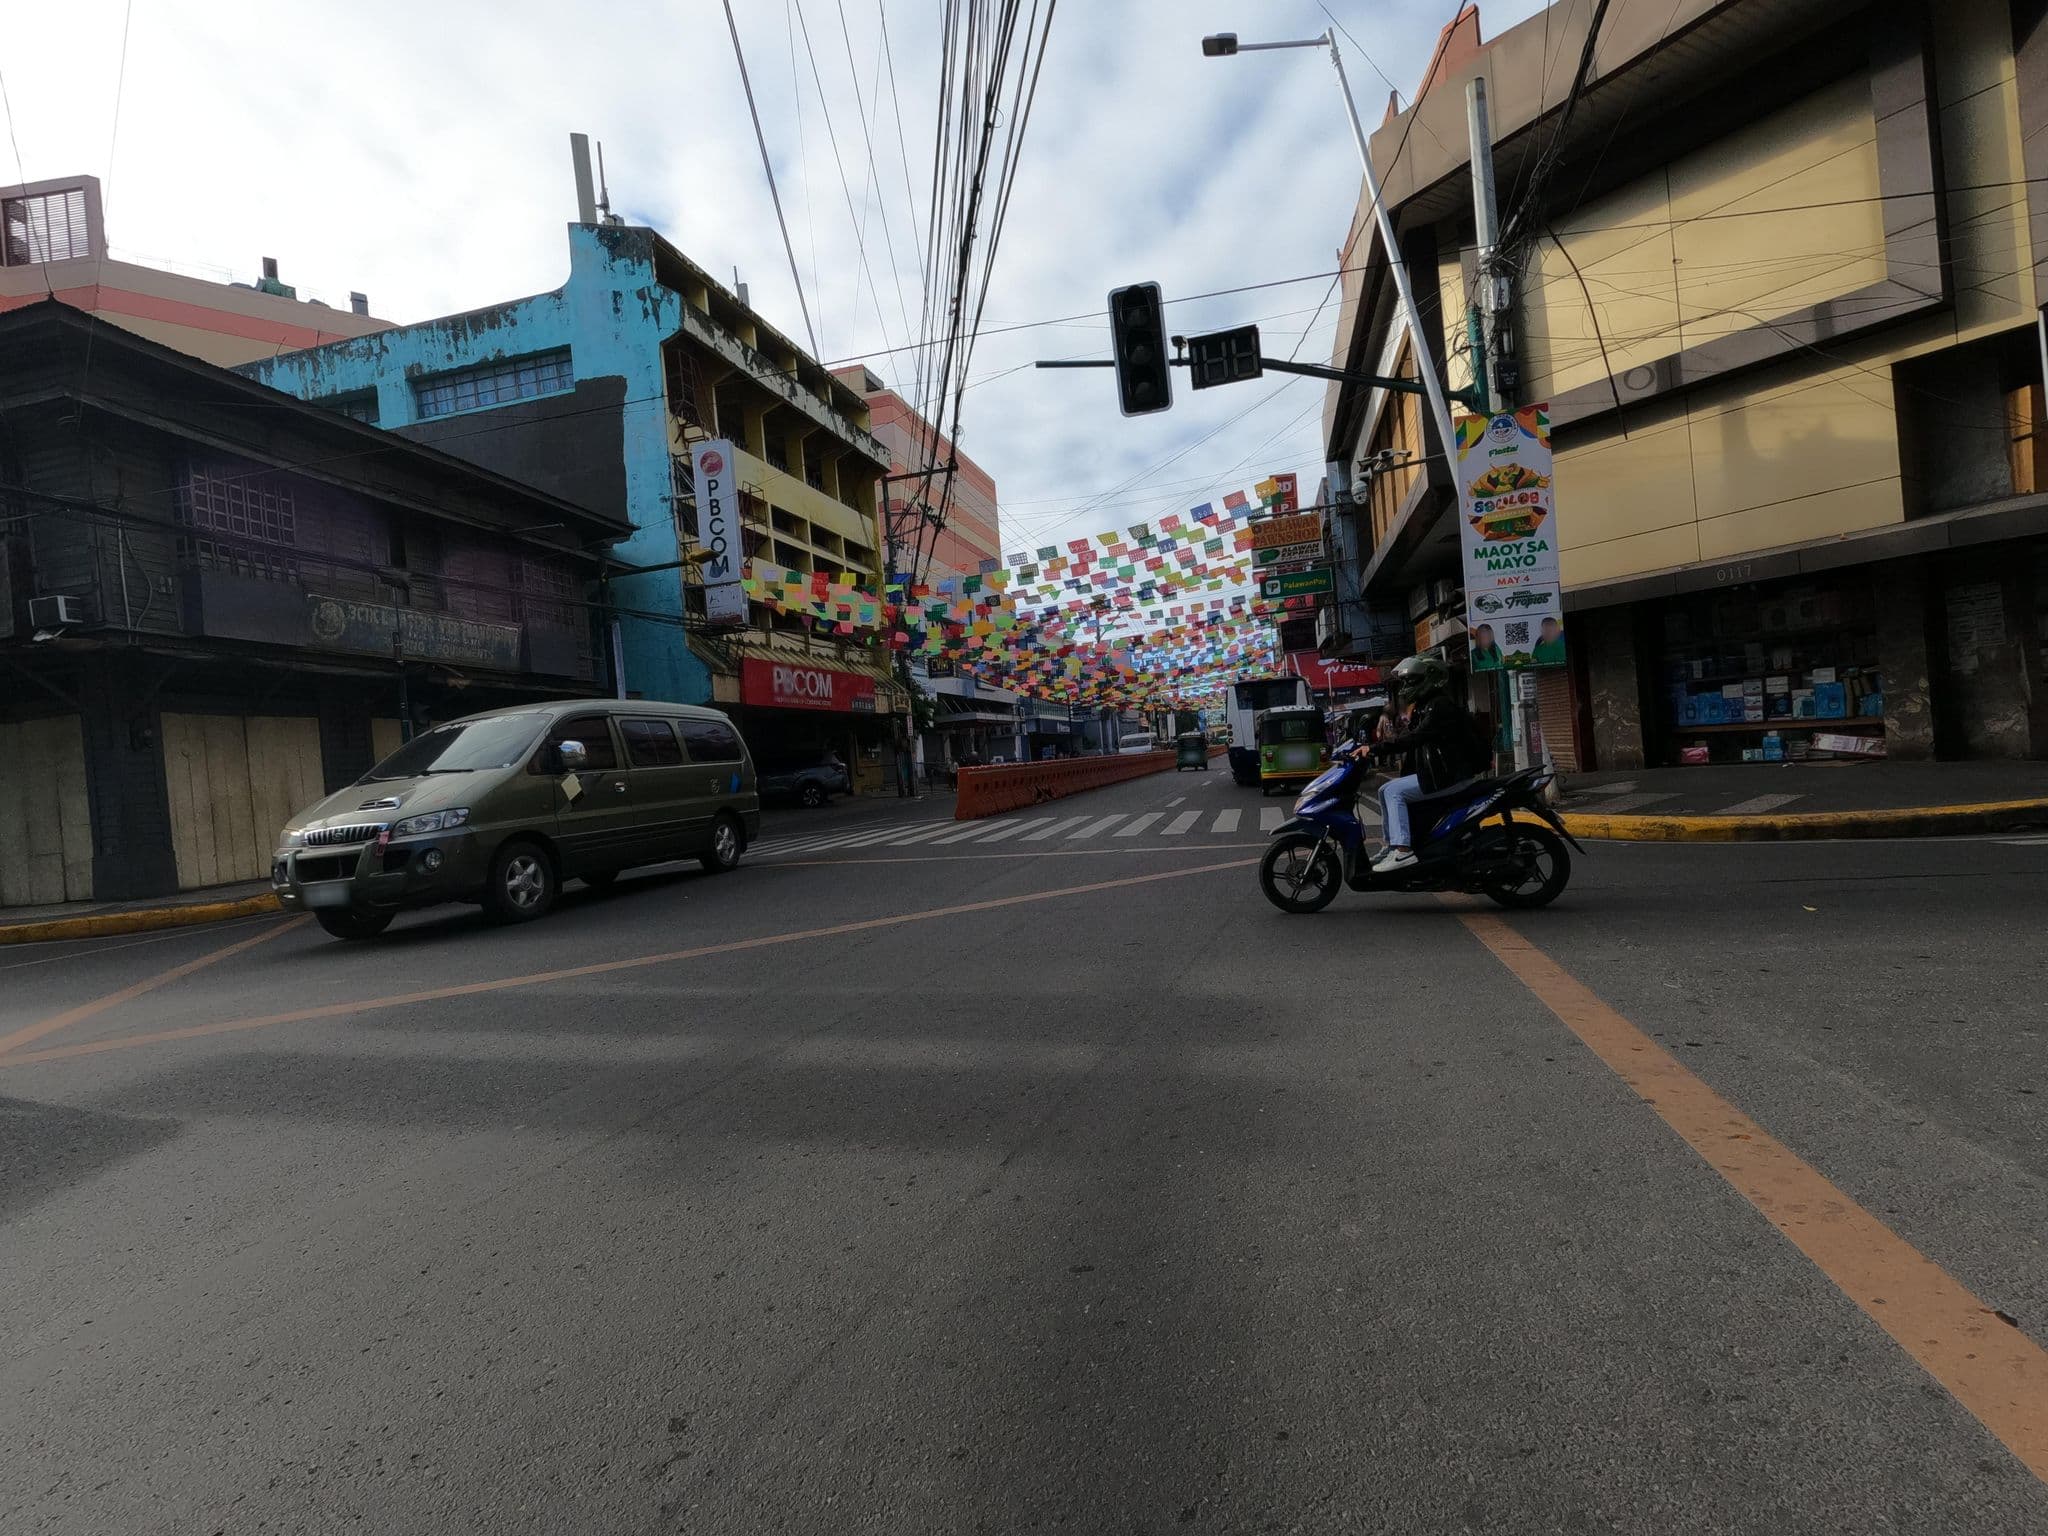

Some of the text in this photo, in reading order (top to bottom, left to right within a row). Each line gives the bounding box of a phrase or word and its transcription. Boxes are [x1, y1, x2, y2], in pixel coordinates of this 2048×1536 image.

[707, 479, 729, 573] PBCOM
[1266, 515, 1318, 534] PALAWAN
[1474, 540, 1549, 559] MAOY SA
[1487, 554, 1536, 570] MAYO
[1497, 576, 1521, 586] MAY
[1505, 592, 1552, 609] Tropics
[772, 666, 833, 699] PBCOM
